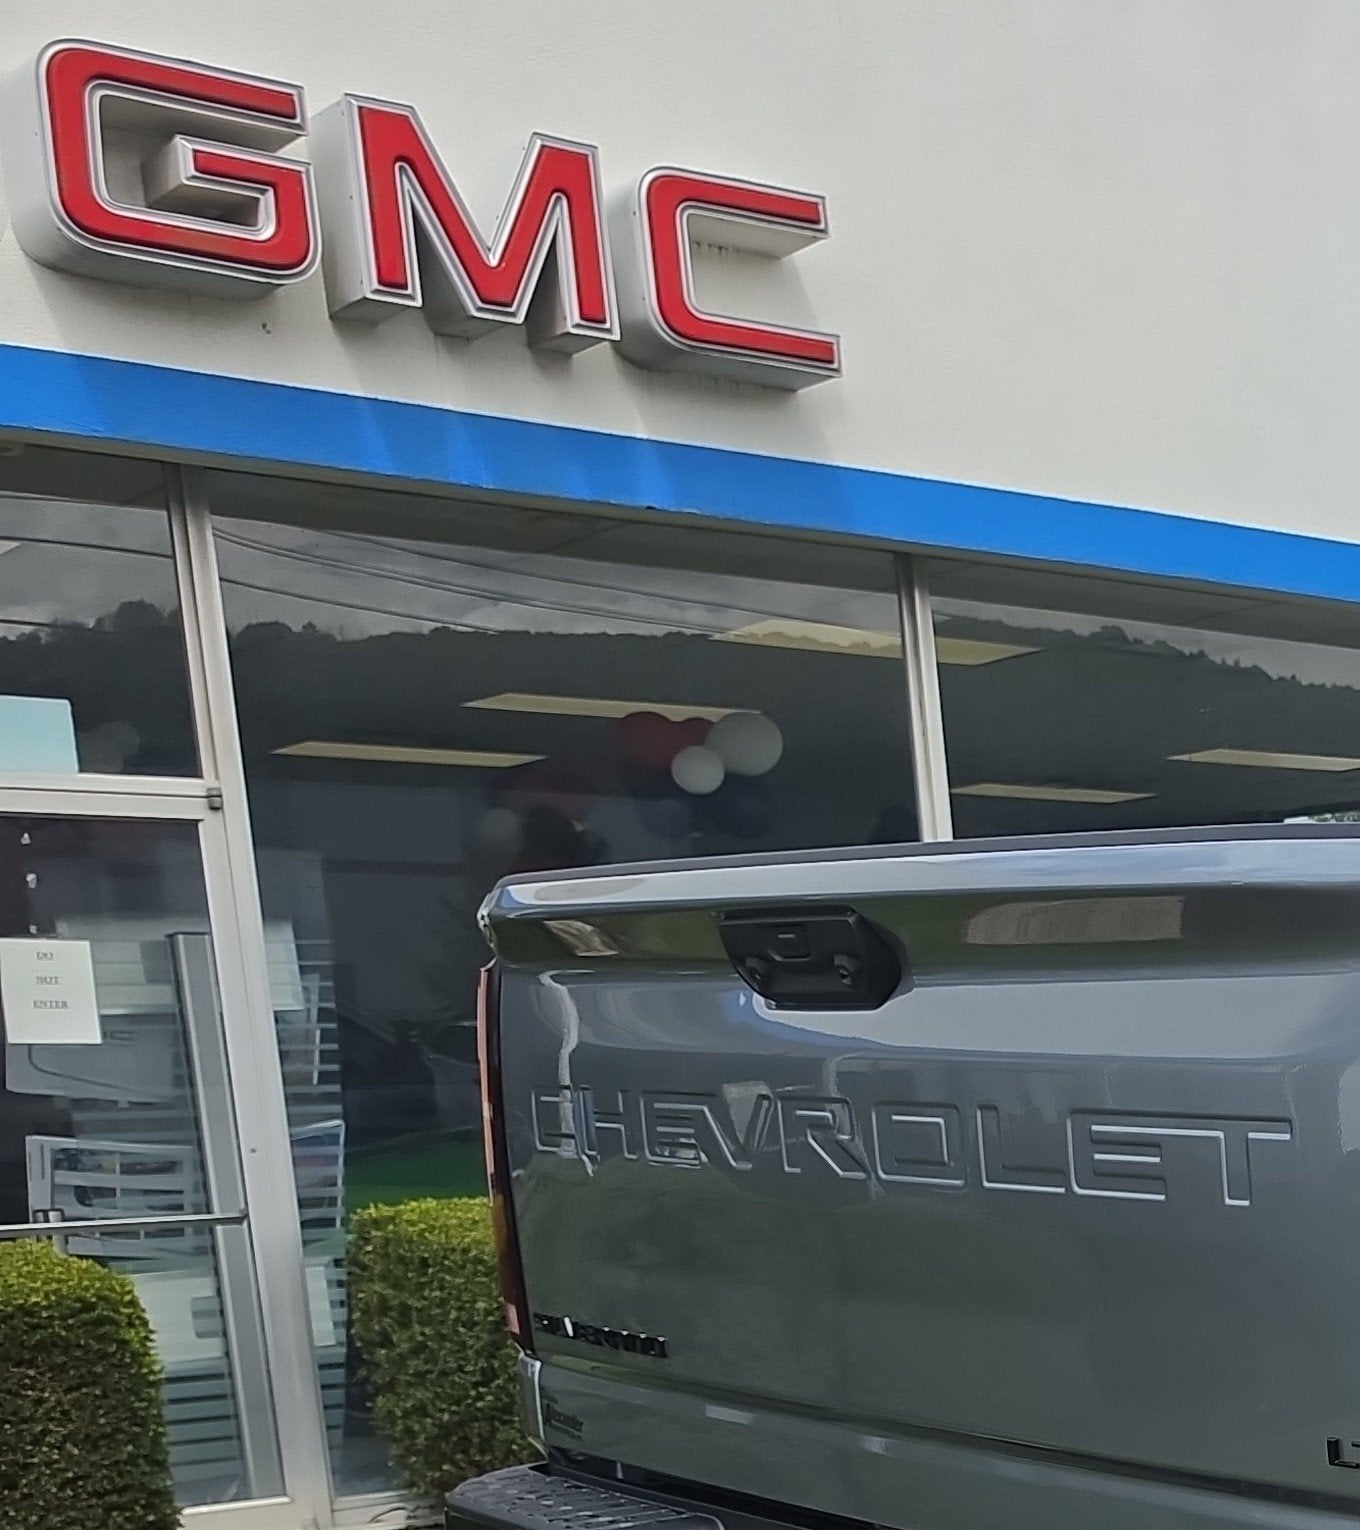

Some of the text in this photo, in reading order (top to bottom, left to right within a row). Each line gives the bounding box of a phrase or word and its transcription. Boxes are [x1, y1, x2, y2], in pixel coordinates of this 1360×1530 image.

[30, 38, 843, 385] GMC
[33, 1000, 69, 1009] ENTER
[530, 1082, 1294, 1208] CHEVROLET
